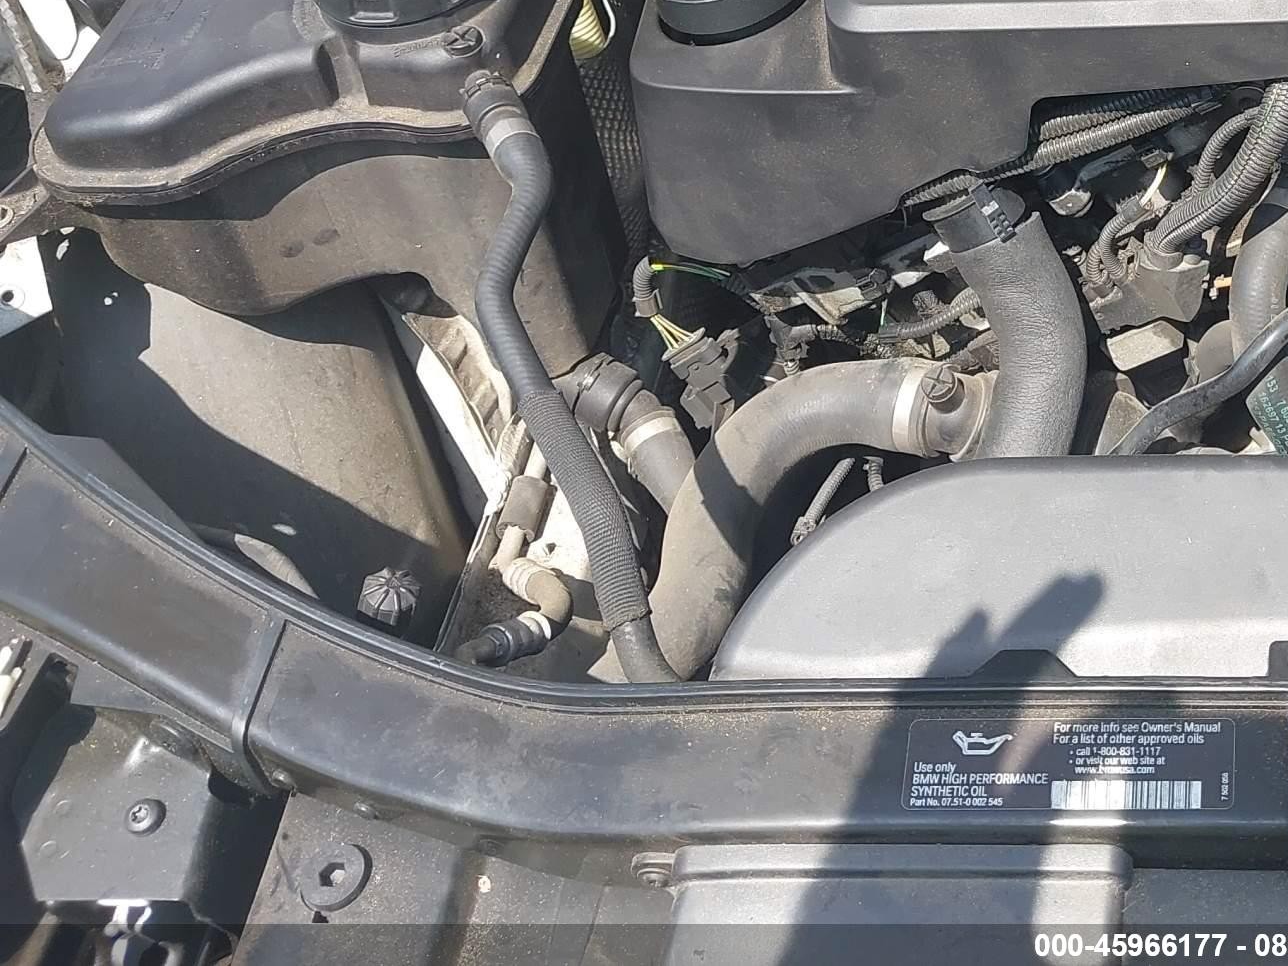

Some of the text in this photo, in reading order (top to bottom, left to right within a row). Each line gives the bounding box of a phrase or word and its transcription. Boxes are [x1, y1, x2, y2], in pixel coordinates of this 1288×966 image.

[1265, 375, 1279, 393] 153
[1053, 721, 1221, 733] For more info see Owner's Manual
[1053, 733, 1205, 746] For a list of other approved oils
[1075, 746, 1162, 756] call 1-800-831-1117
[1075, 756, 1166, 765] or visit our web site at
[913, 761, 957, 775] Use only
[912, 772, 1049, 785] BMW HIGH PERFORMANCE
[911, 785, 988, 797] SYNTHETIC OIL
[910, 797, 926, 807] Part
[926, 797, 940, 807] No.
[972, 797, 987, 807] 002
[988, 797, 1004, 807] 545
